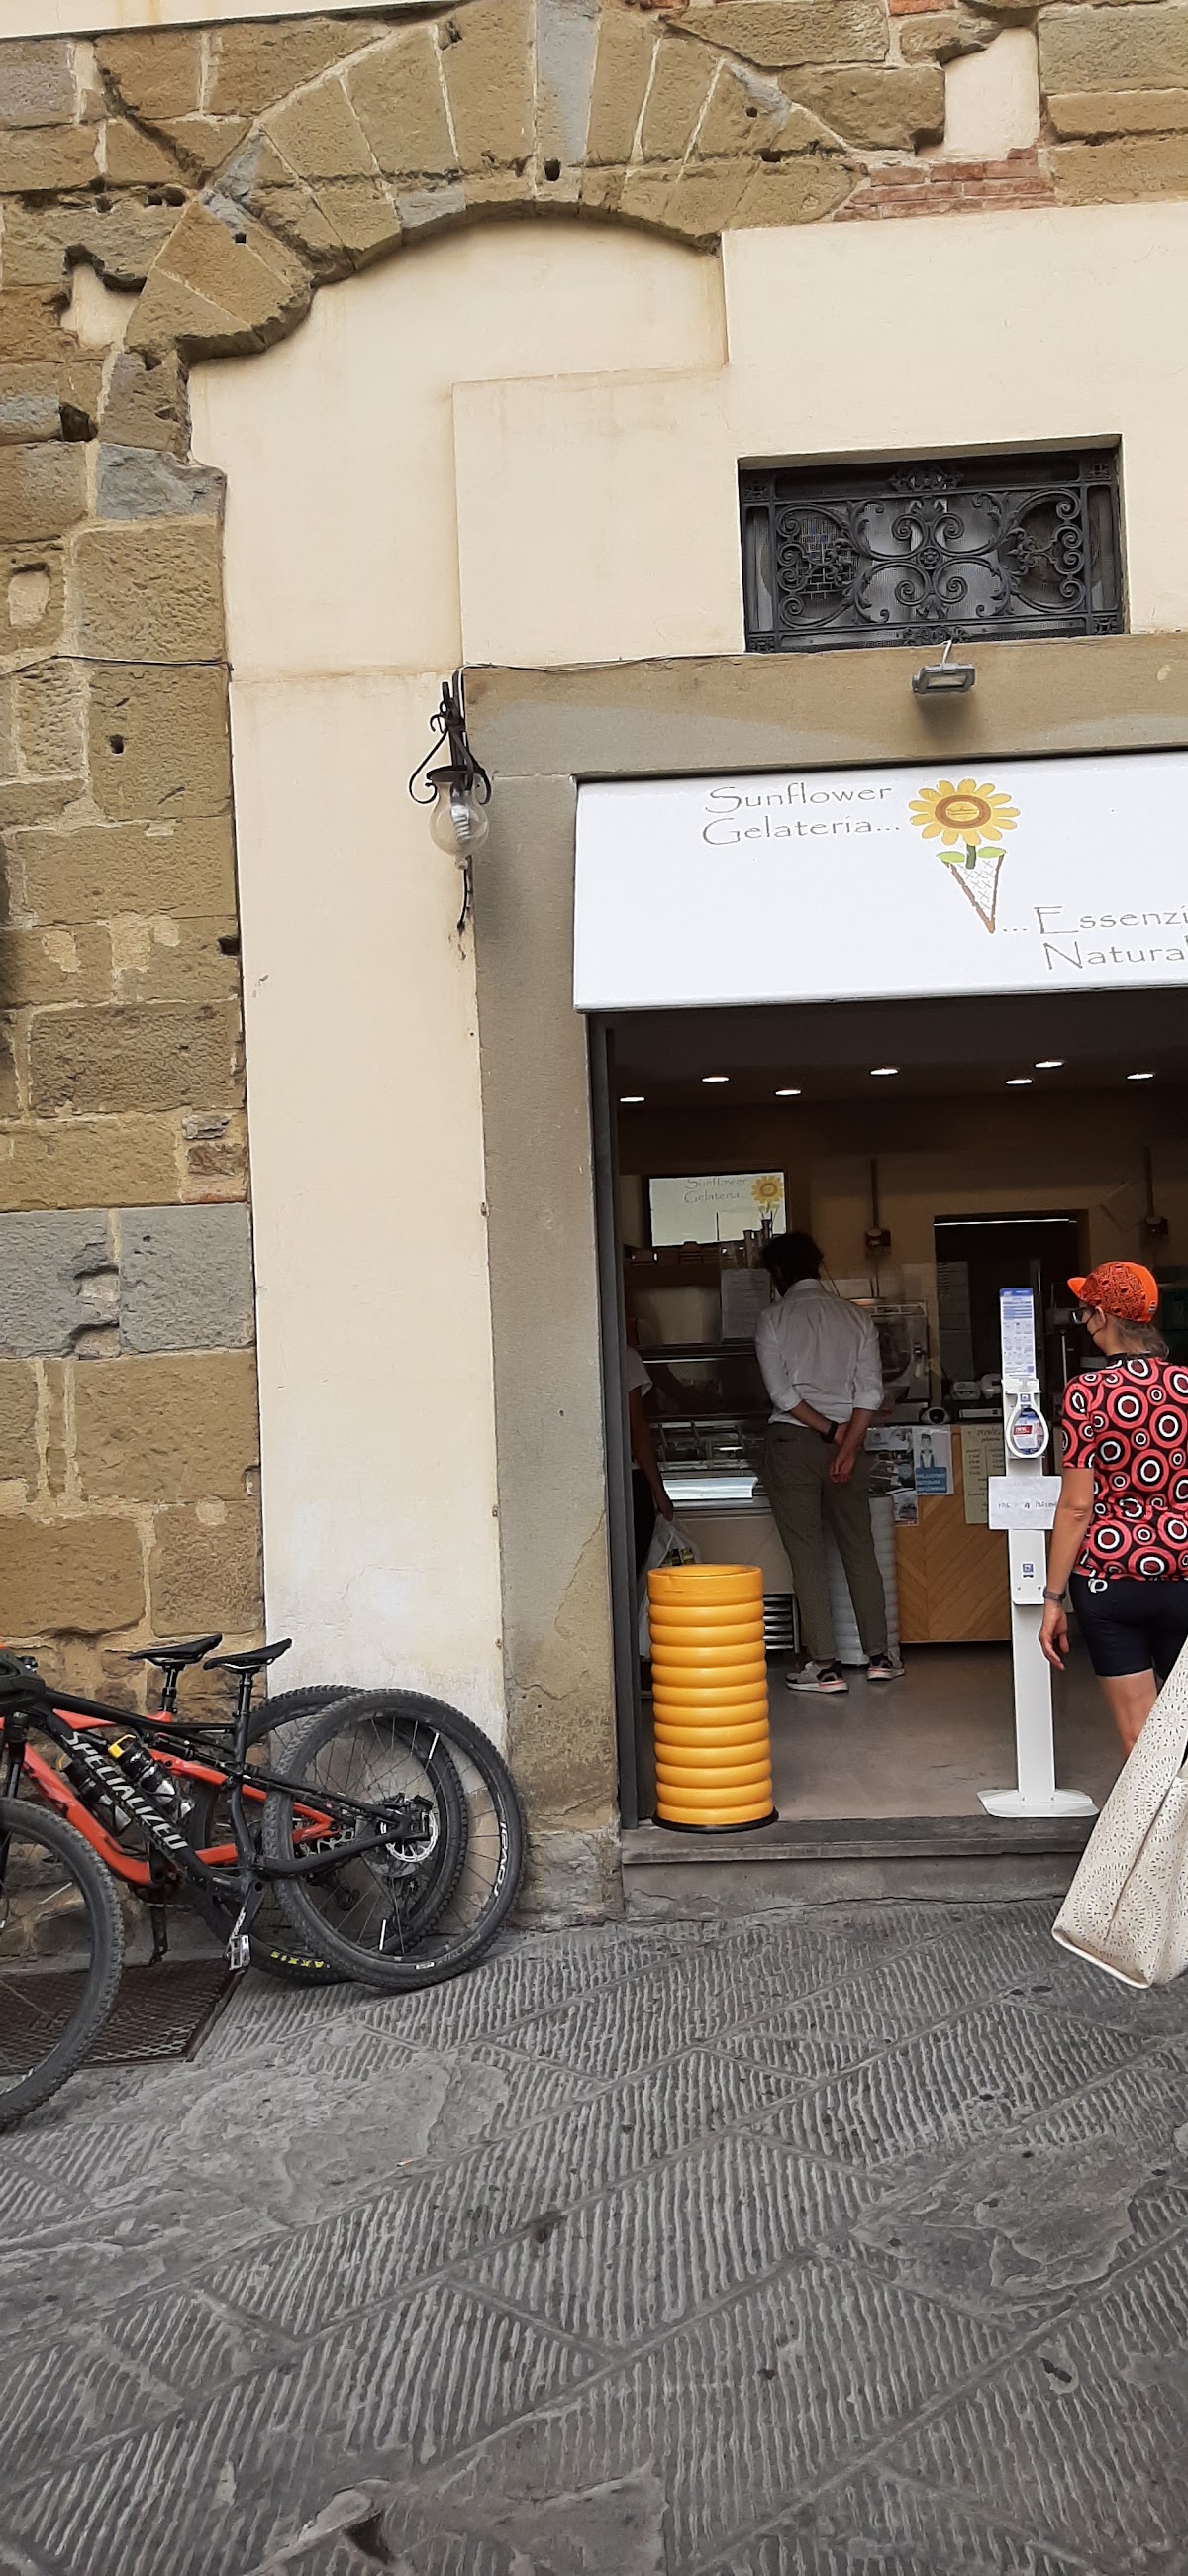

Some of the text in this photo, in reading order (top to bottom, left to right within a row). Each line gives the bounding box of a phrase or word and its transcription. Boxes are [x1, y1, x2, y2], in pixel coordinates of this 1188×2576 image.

[705, 782, 892, 813] Sunflower
[685, 1178, 747, 1189] Sunflower
[61, 1732, 188, 1850] SPECIALIZED
[270, 1951, 331, 1969] AXXIS
